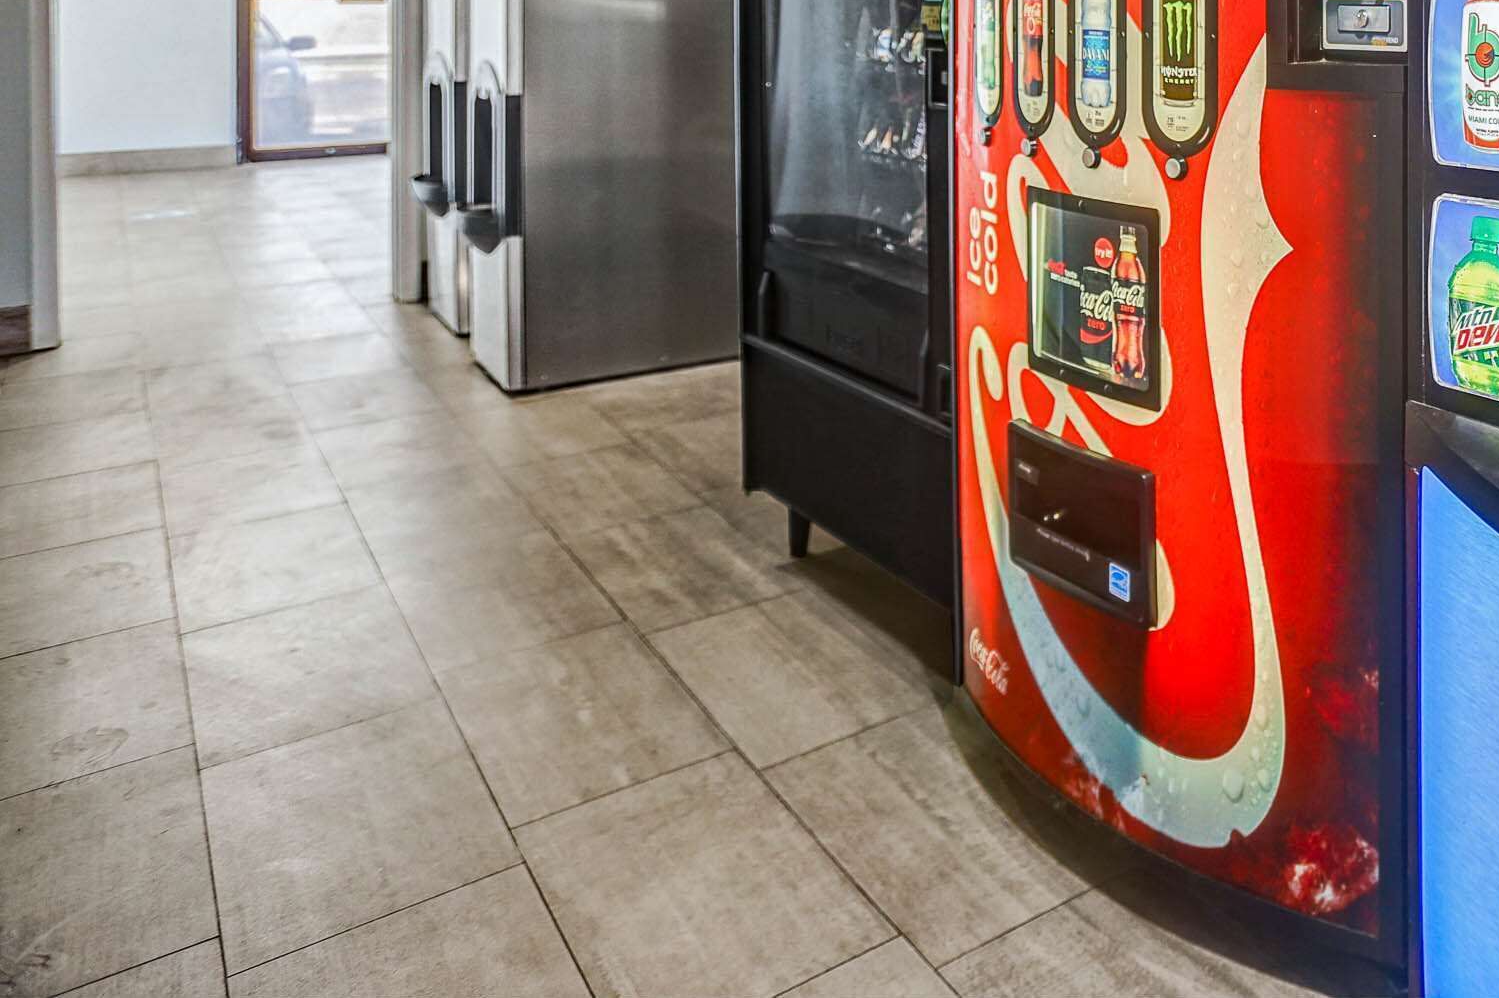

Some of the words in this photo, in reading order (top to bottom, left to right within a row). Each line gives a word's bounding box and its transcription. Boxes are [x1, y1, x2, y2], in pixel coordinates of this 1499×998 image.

[1468, 115, 1487, 124] MIAMI
[967, 207, 982, 286] Ice
[980, 170, 998, 295] cold
